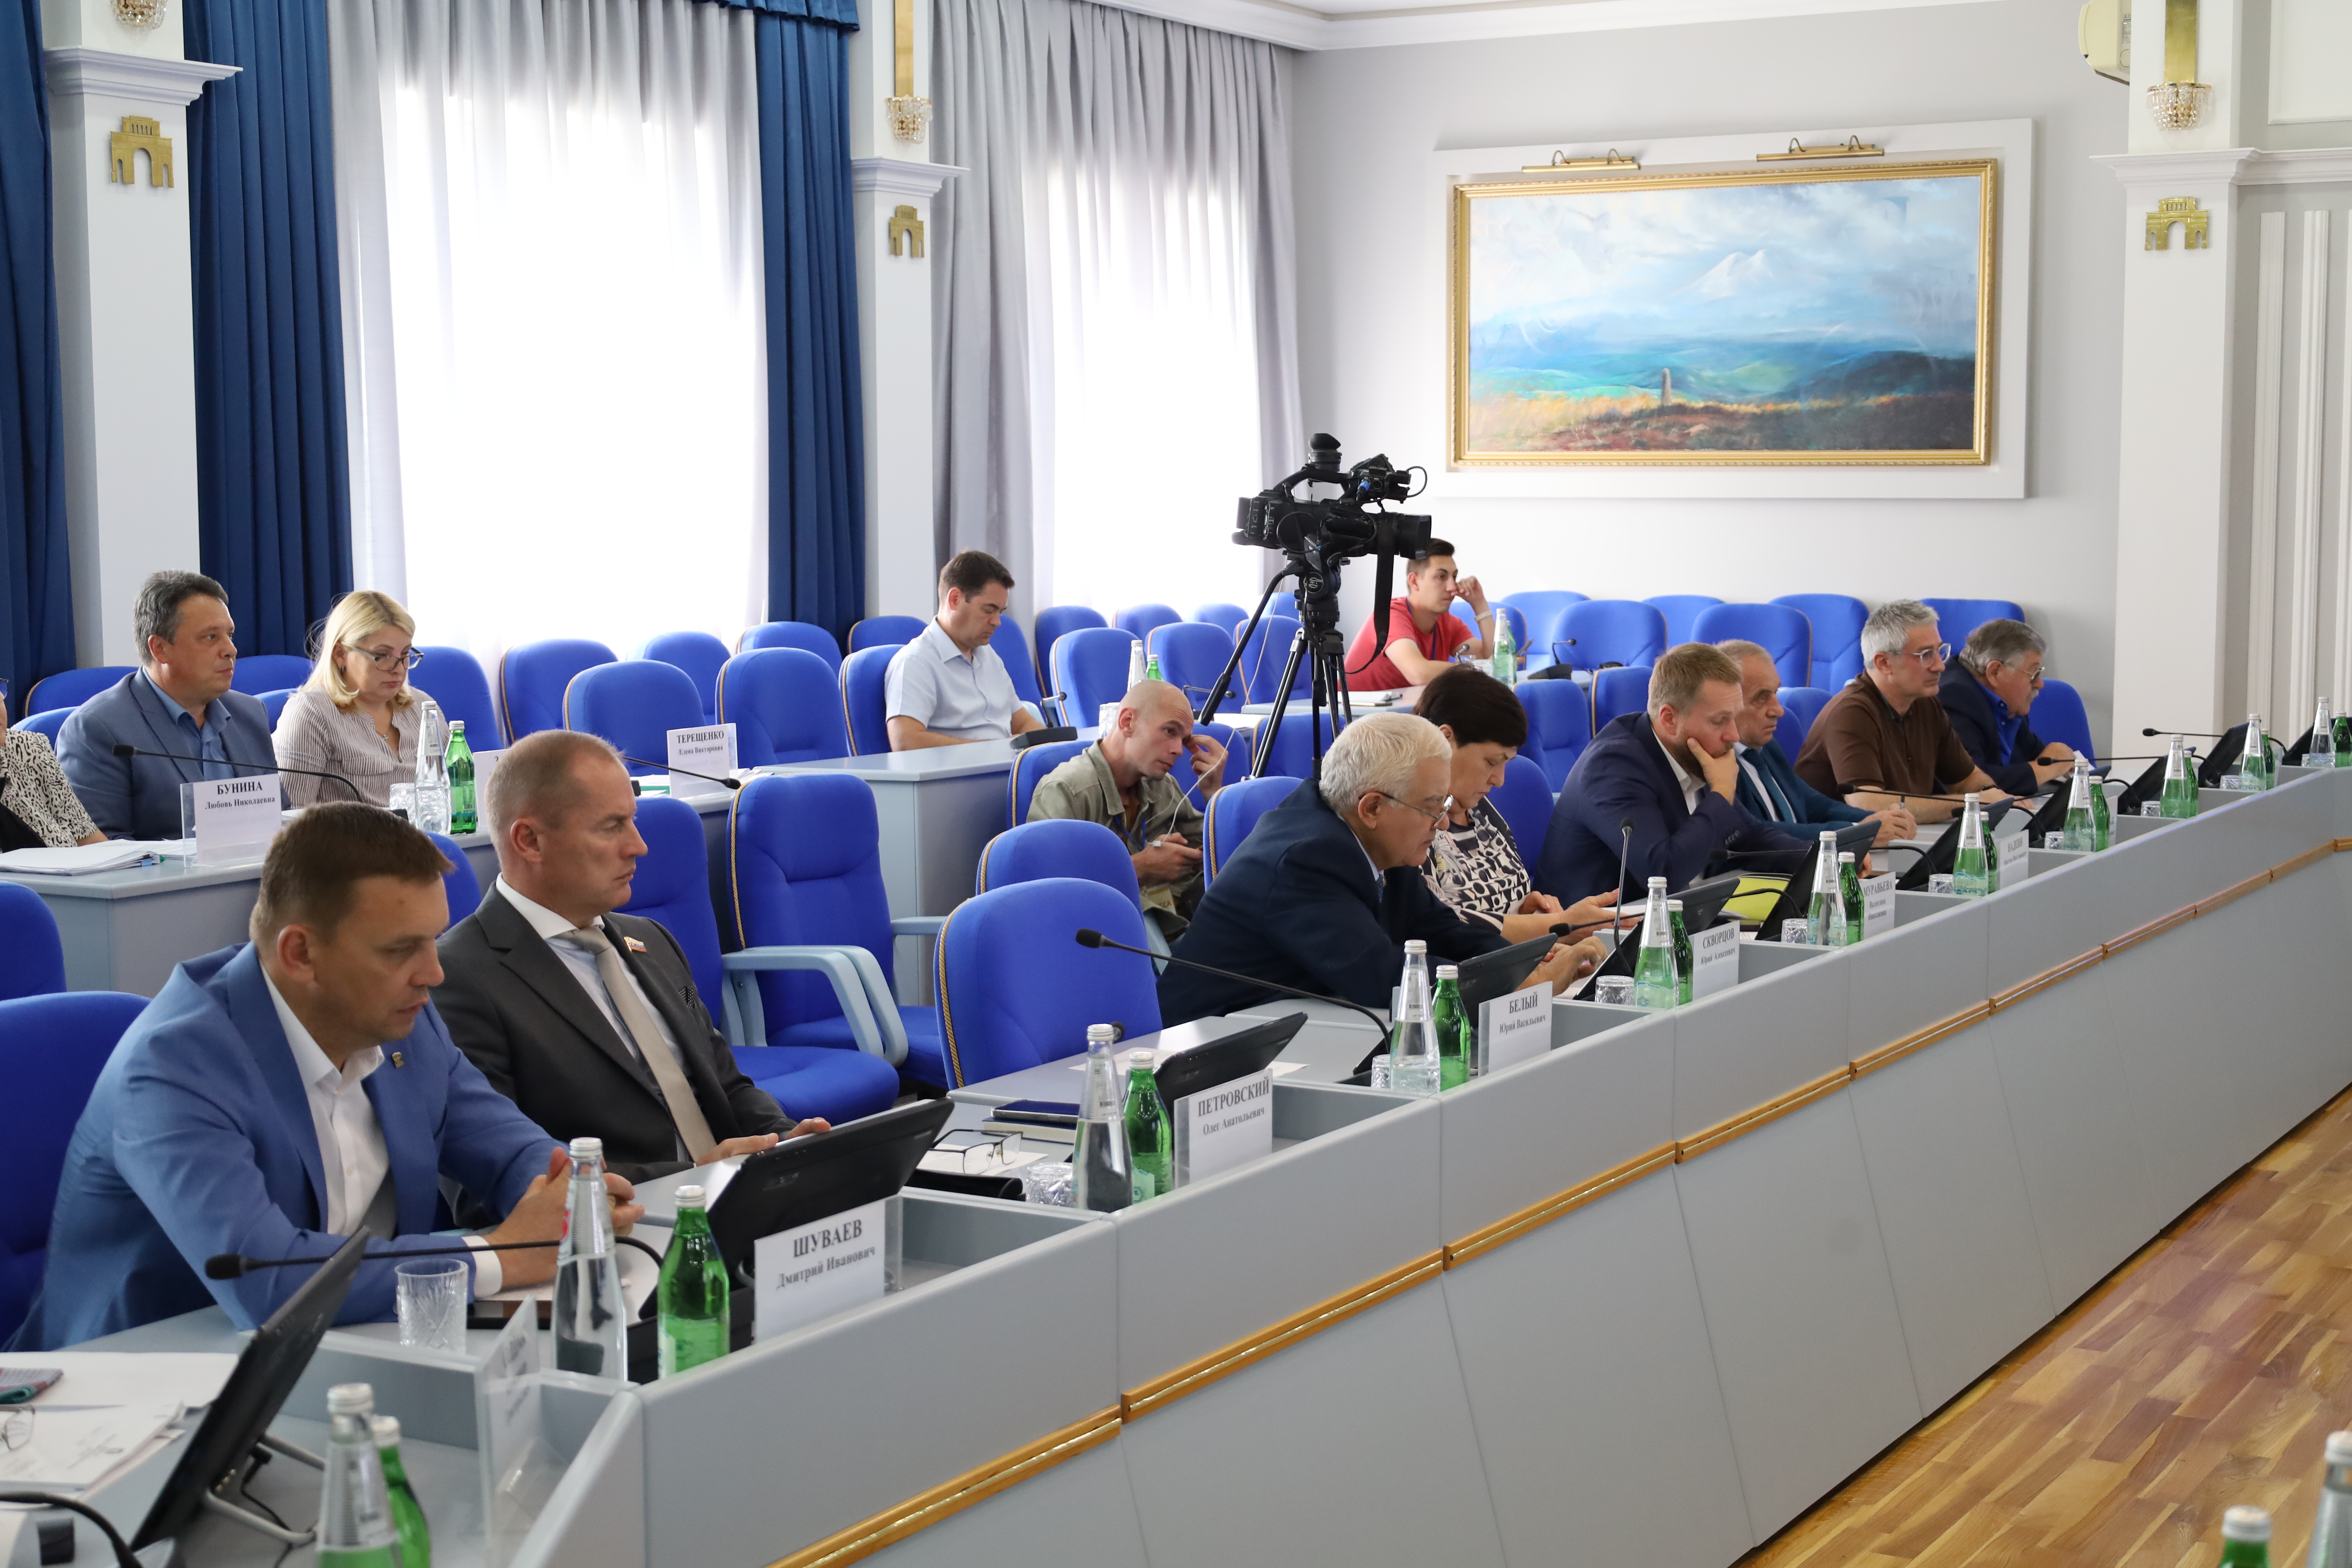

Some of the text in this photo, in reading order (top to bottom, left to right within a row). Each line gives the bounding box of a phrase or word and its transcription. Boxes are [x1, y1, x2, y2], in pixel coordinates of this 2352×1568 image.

[677, 730, 724, 744] ТЕРЕЩЕНКО
[695, 745, 723, 753] Викторовна
[217, 781, 263, 795] БУНИНА
[205, 797, 275, 809] Любовь Николаевна
[1864, 880, 1893, 896] МУРАВЬЕВА
[1703, 928, 1734, 949] СКВОРЦОВ
[1701, 947, 1735, 966] Юрий Алексеевич
[1509, 991, 1538, 1014] БЕЛЫЙ
[1500, 1015, 1546, 1034] Юрий Васильевич
[1198, 1075, 1269, 1116] ПЕТРОВСКИЙ
[1203, 1107, 1265, 1135] Олег Анатольевич
[793, 1219, 862, 1257] ШУВАЕВ
[776, 1246, 876, 1291] Дмитрий Иванович
